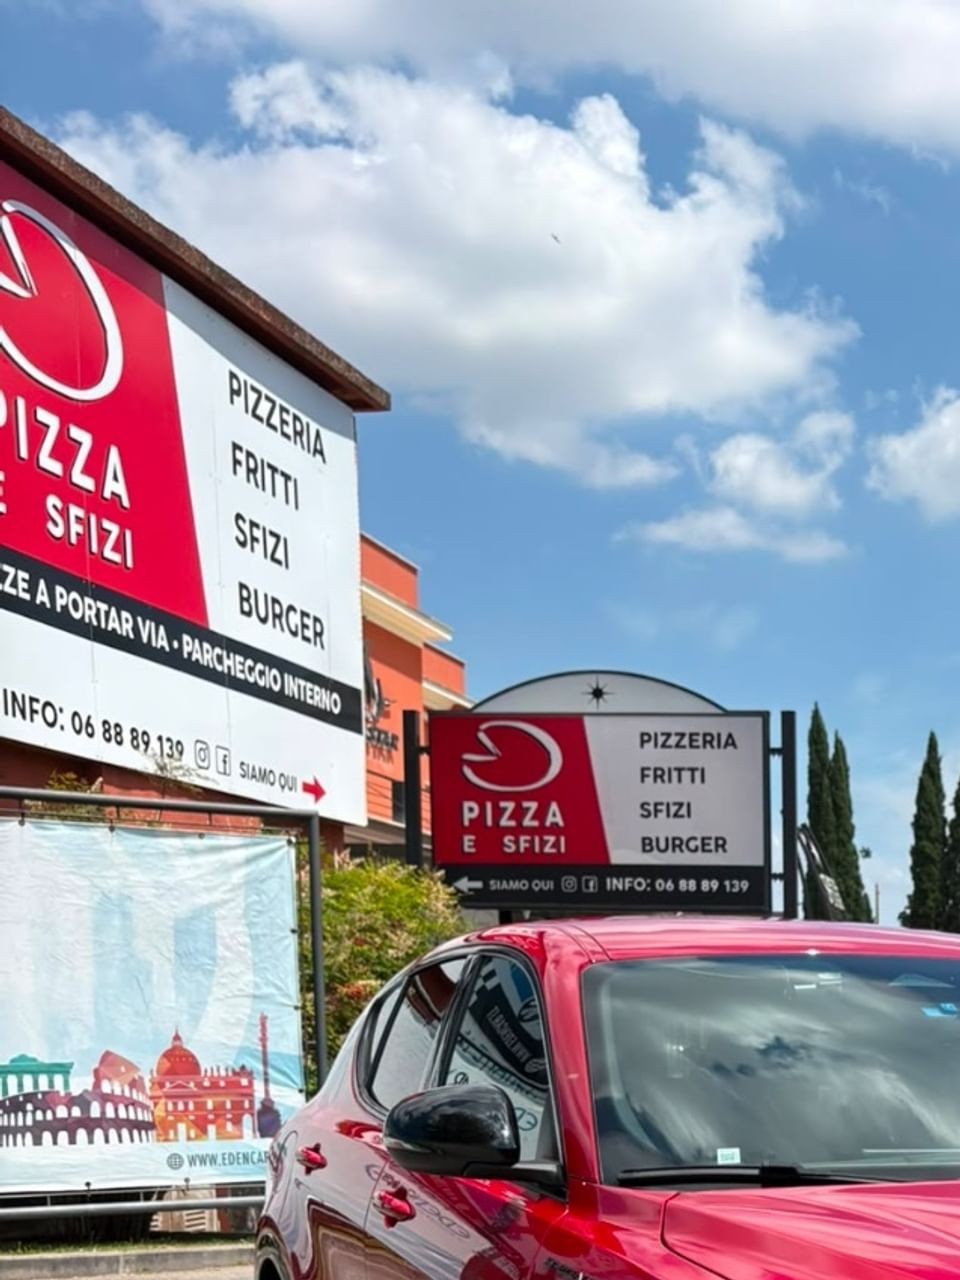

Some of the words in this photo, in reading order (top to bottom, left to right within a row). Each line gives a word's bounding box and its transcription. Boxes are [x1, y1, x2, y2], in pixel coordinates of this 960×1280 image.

[228, 368, 326, 464] PIZZERIA
[231, 440, 299, 511] FRITTI
[45, 493, 133, 570] SFIZI
[234, 512, 289, 570] SFIZI
[238, 581, 325, 650] BURGER
[0, 564, 31, 601] ZE
[36, 578, 51, 609] A
[55, 584, 134, 640] PORTAR
[137, 616, 170, 652] VIA
[182, 633, 281, 692] PARCHEGGIO
[284, 672, 342, 715] INTERNO
[3, 688, 65, 731] INFO:
[71, 710, 95, 738] 06
[101, 719, 124, 746] 88
[130, 727, 150, 753] 89
[157, 735, 184, 759] 139
[239, 761, 276, 787] SIAMO
[278, 773, 298, 793] QUI
[639, 732, 738, 750] PIZZERIA
[640, 767, 706, 785] FRITTI
[462, 801, 564, 828] PIZZA
[639, 801, 692, 819] SFIZI
[462, 834, 476, 853] E
[503, 834, 566, 854] SFIZI
[641, 835, 728, 854] BURGER
[489, 879, 529, 891] SIAMO
[531, 879, 554, 892] QUI
[606, 876, 651, 893] INFO:
[655, 879, 674, 892] 06
[678, 879, 697, 892] 88
[701, 879, 719, 892] 89
[723, 879, 749, 893] 139
